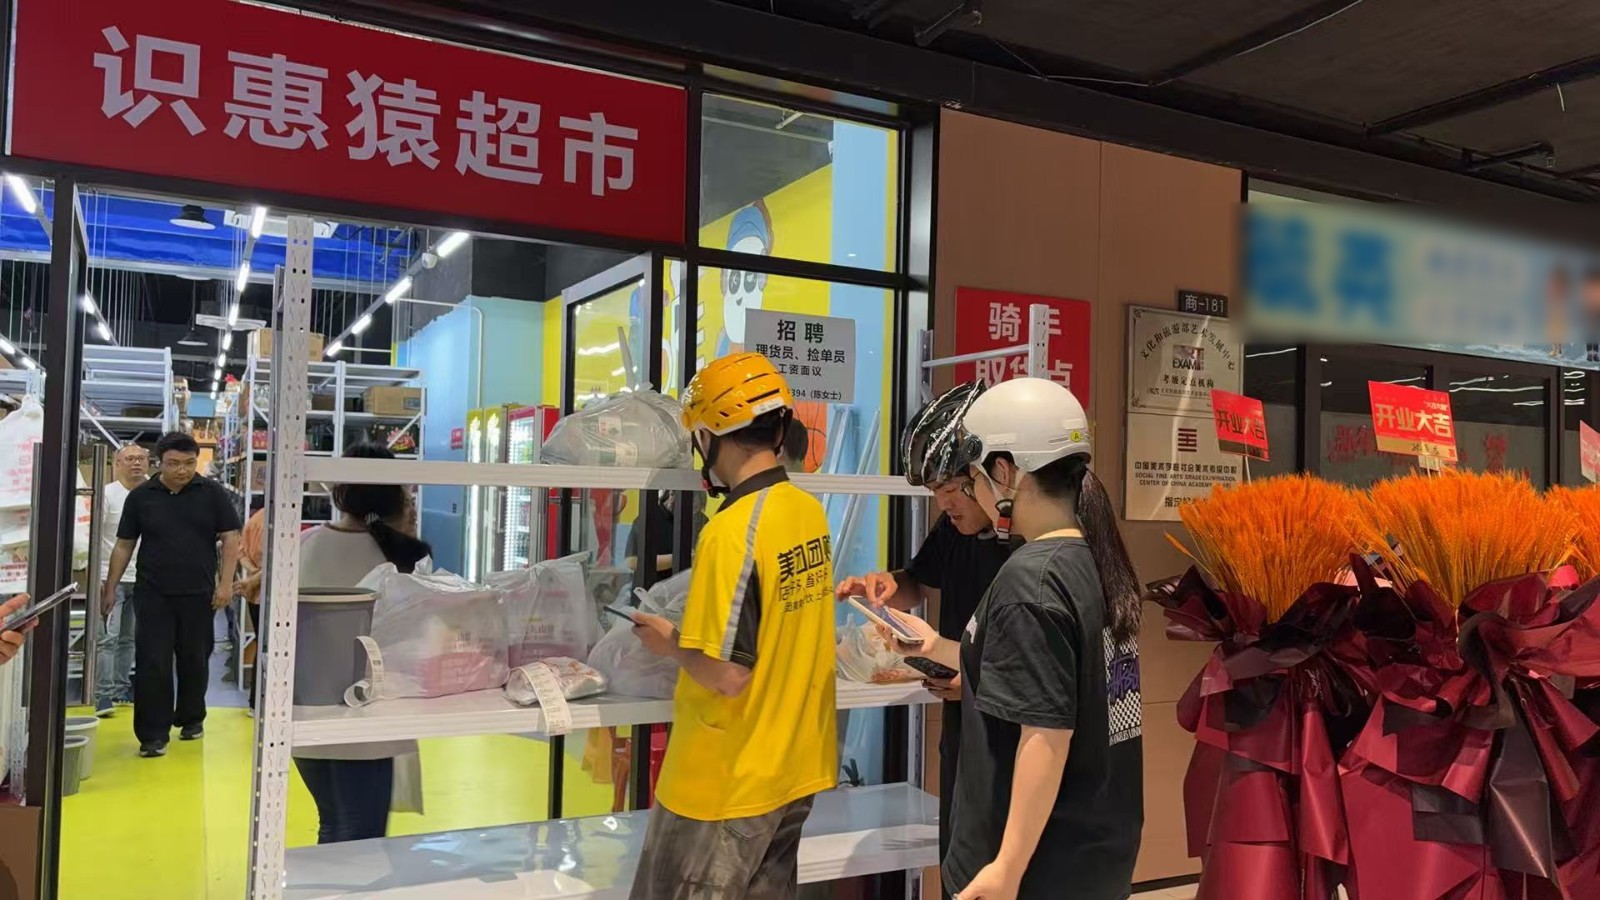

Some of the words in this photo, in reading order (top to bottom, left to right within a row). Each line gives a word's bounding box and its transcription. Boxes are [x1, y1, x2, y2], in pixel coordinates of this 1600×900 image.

[93, 25, 639, 197] 识惠猿超市
[1185, 294, 1225, 312] 商-181
[778, 363, 822, 376] 工资面议
[1216, 409, 1265, 440] 开业大吉
[1374, 403, 1452, 438] 开业大吉
